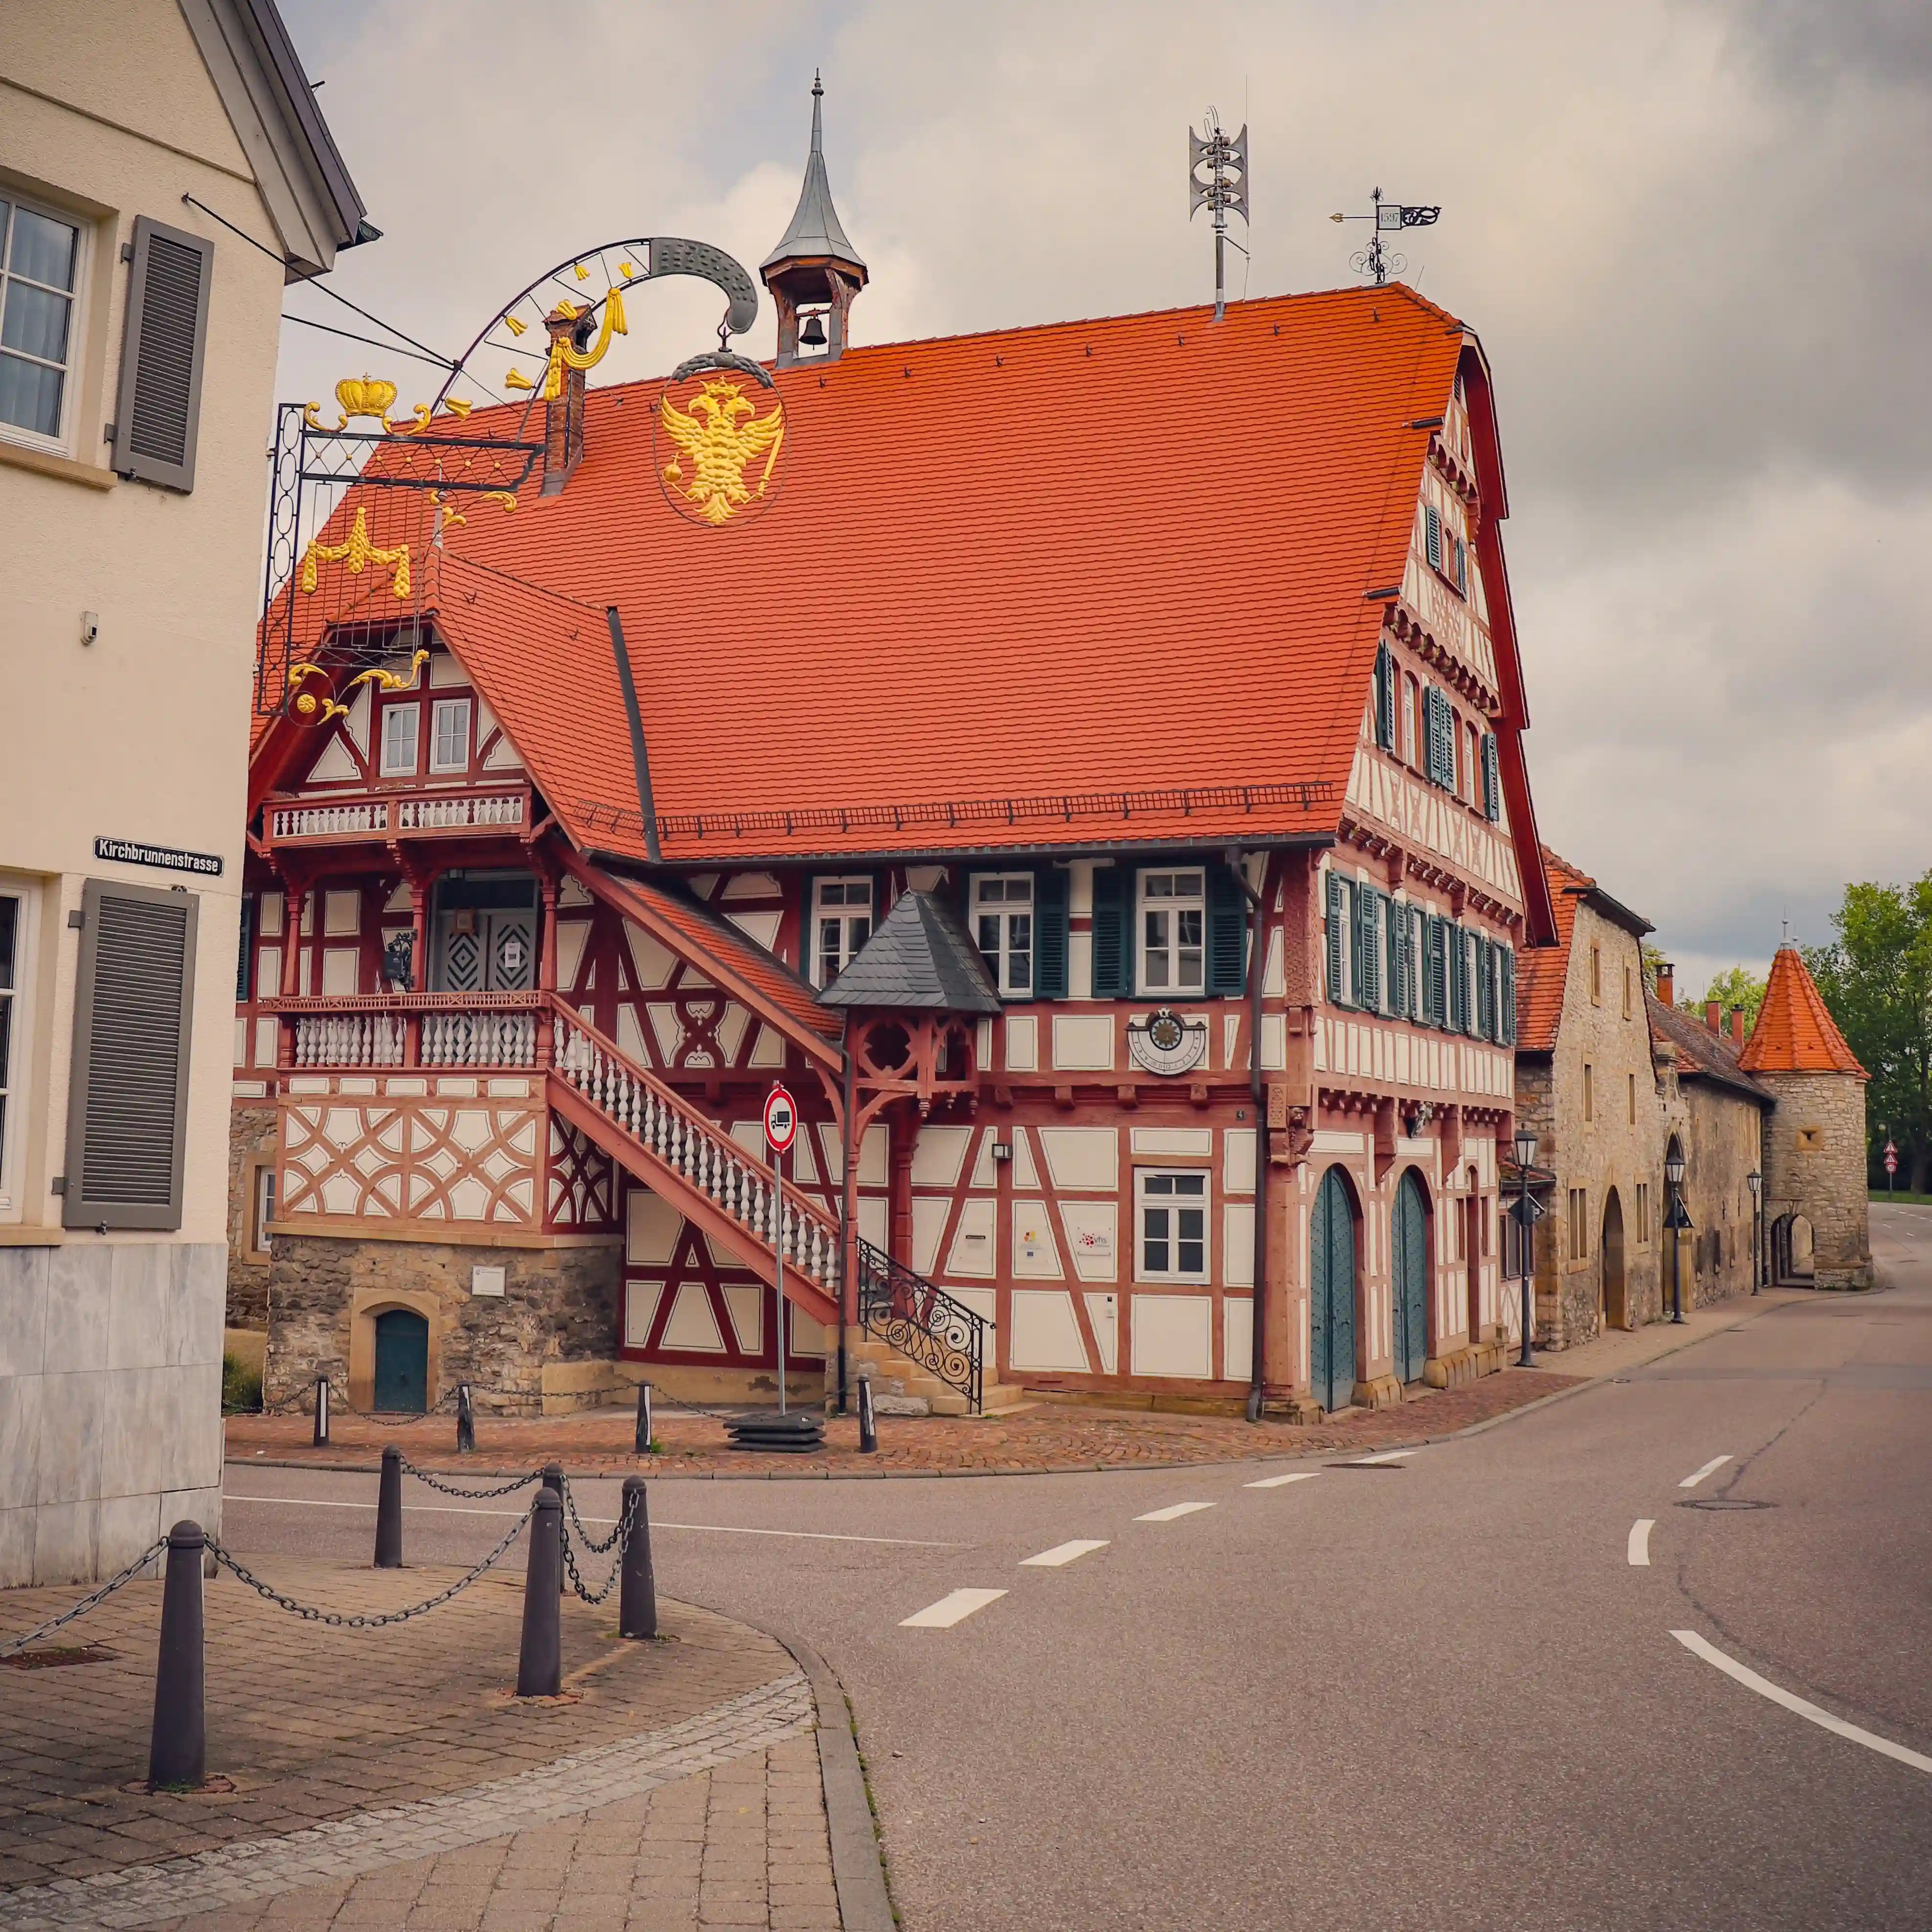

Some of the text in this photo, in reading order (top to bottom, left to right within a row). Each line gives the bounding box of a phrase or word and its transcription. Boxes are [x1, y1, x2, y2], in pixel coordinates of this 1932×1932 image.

[1381, 212, 1400, 222] 1597
[99, 839, 218, 872] Kirchbrunnenstrasse
[1094, 1235, 1107, 1243] vhs
